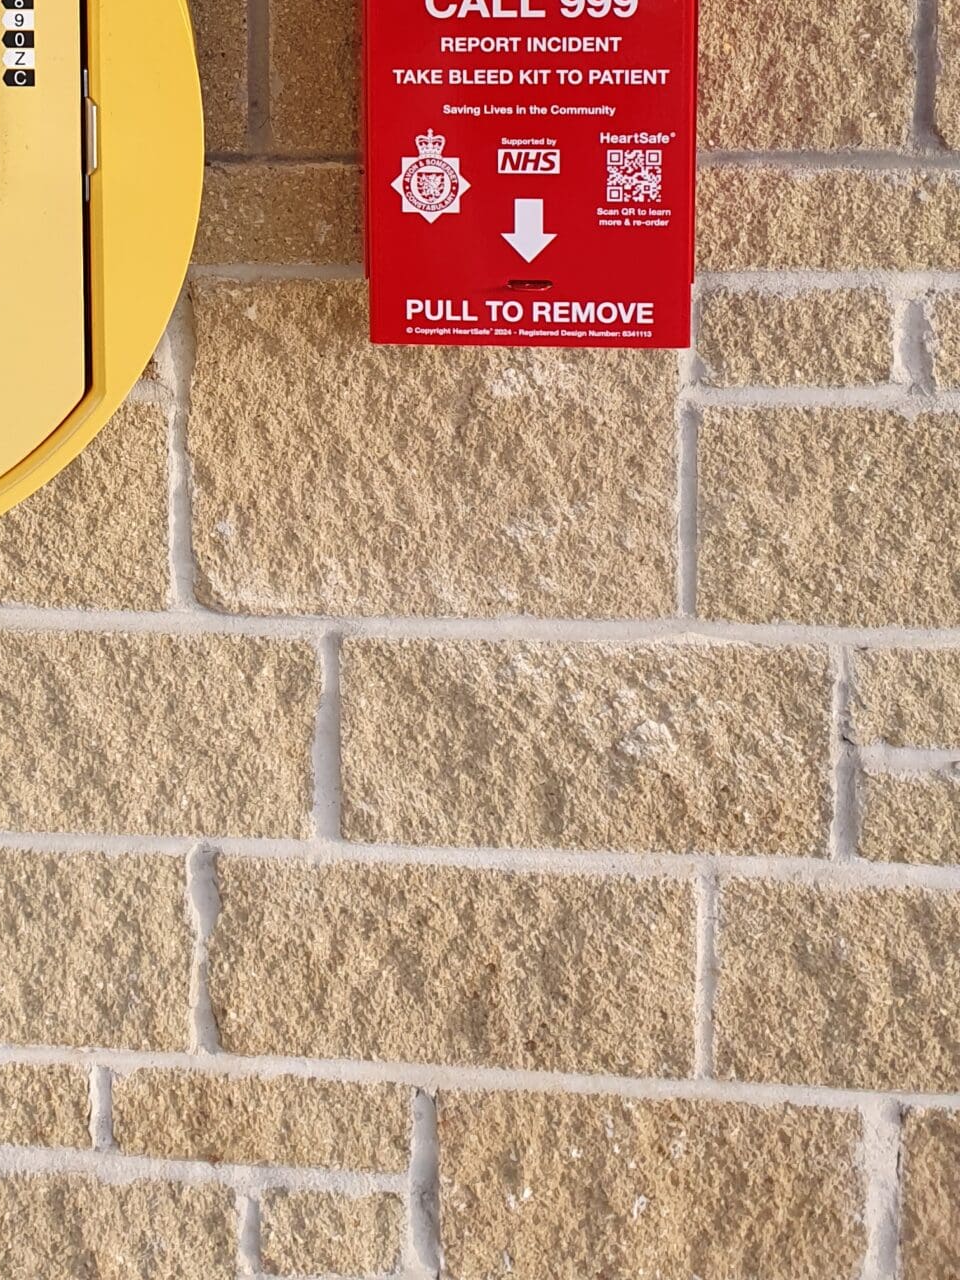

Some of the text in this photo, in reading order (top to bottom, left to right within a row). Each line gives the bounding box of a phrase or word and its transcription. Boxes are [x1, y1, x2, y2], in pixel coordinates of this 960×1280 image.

[13, 13, 25, 27] 9
[14, 33, 25, 47] 0
[440, 36, 623, 53] REPORT INCIDENT
[14, 51, 26, 66] Z
[13, 71, 27, 85] C
[392, 68, 671, 85] TAKE BLEED KIT TO PATIENT
[442, 104, 616, 117] Saving Lives in the Community
[501, 137, 557, 147] Supported by
[500, 151, 557, 171] NHS
[404, 163, 420, 183] AVON
[425, 158, 458, 184] SOMERSET
[405, 191, 456, 212] CONSTABULARY
[596, 207, 672, 216] Scan QR to learn
[598, 218, 670, 226] more & re-order
[406, 299, 655, 324] PULL TO REMOVE
[414, 327, 452, 336] Copyright
[518, 328, 560, 338] Registered
[560, 329, 587, 338] Design
[588, 329, 621, 338] Number:
